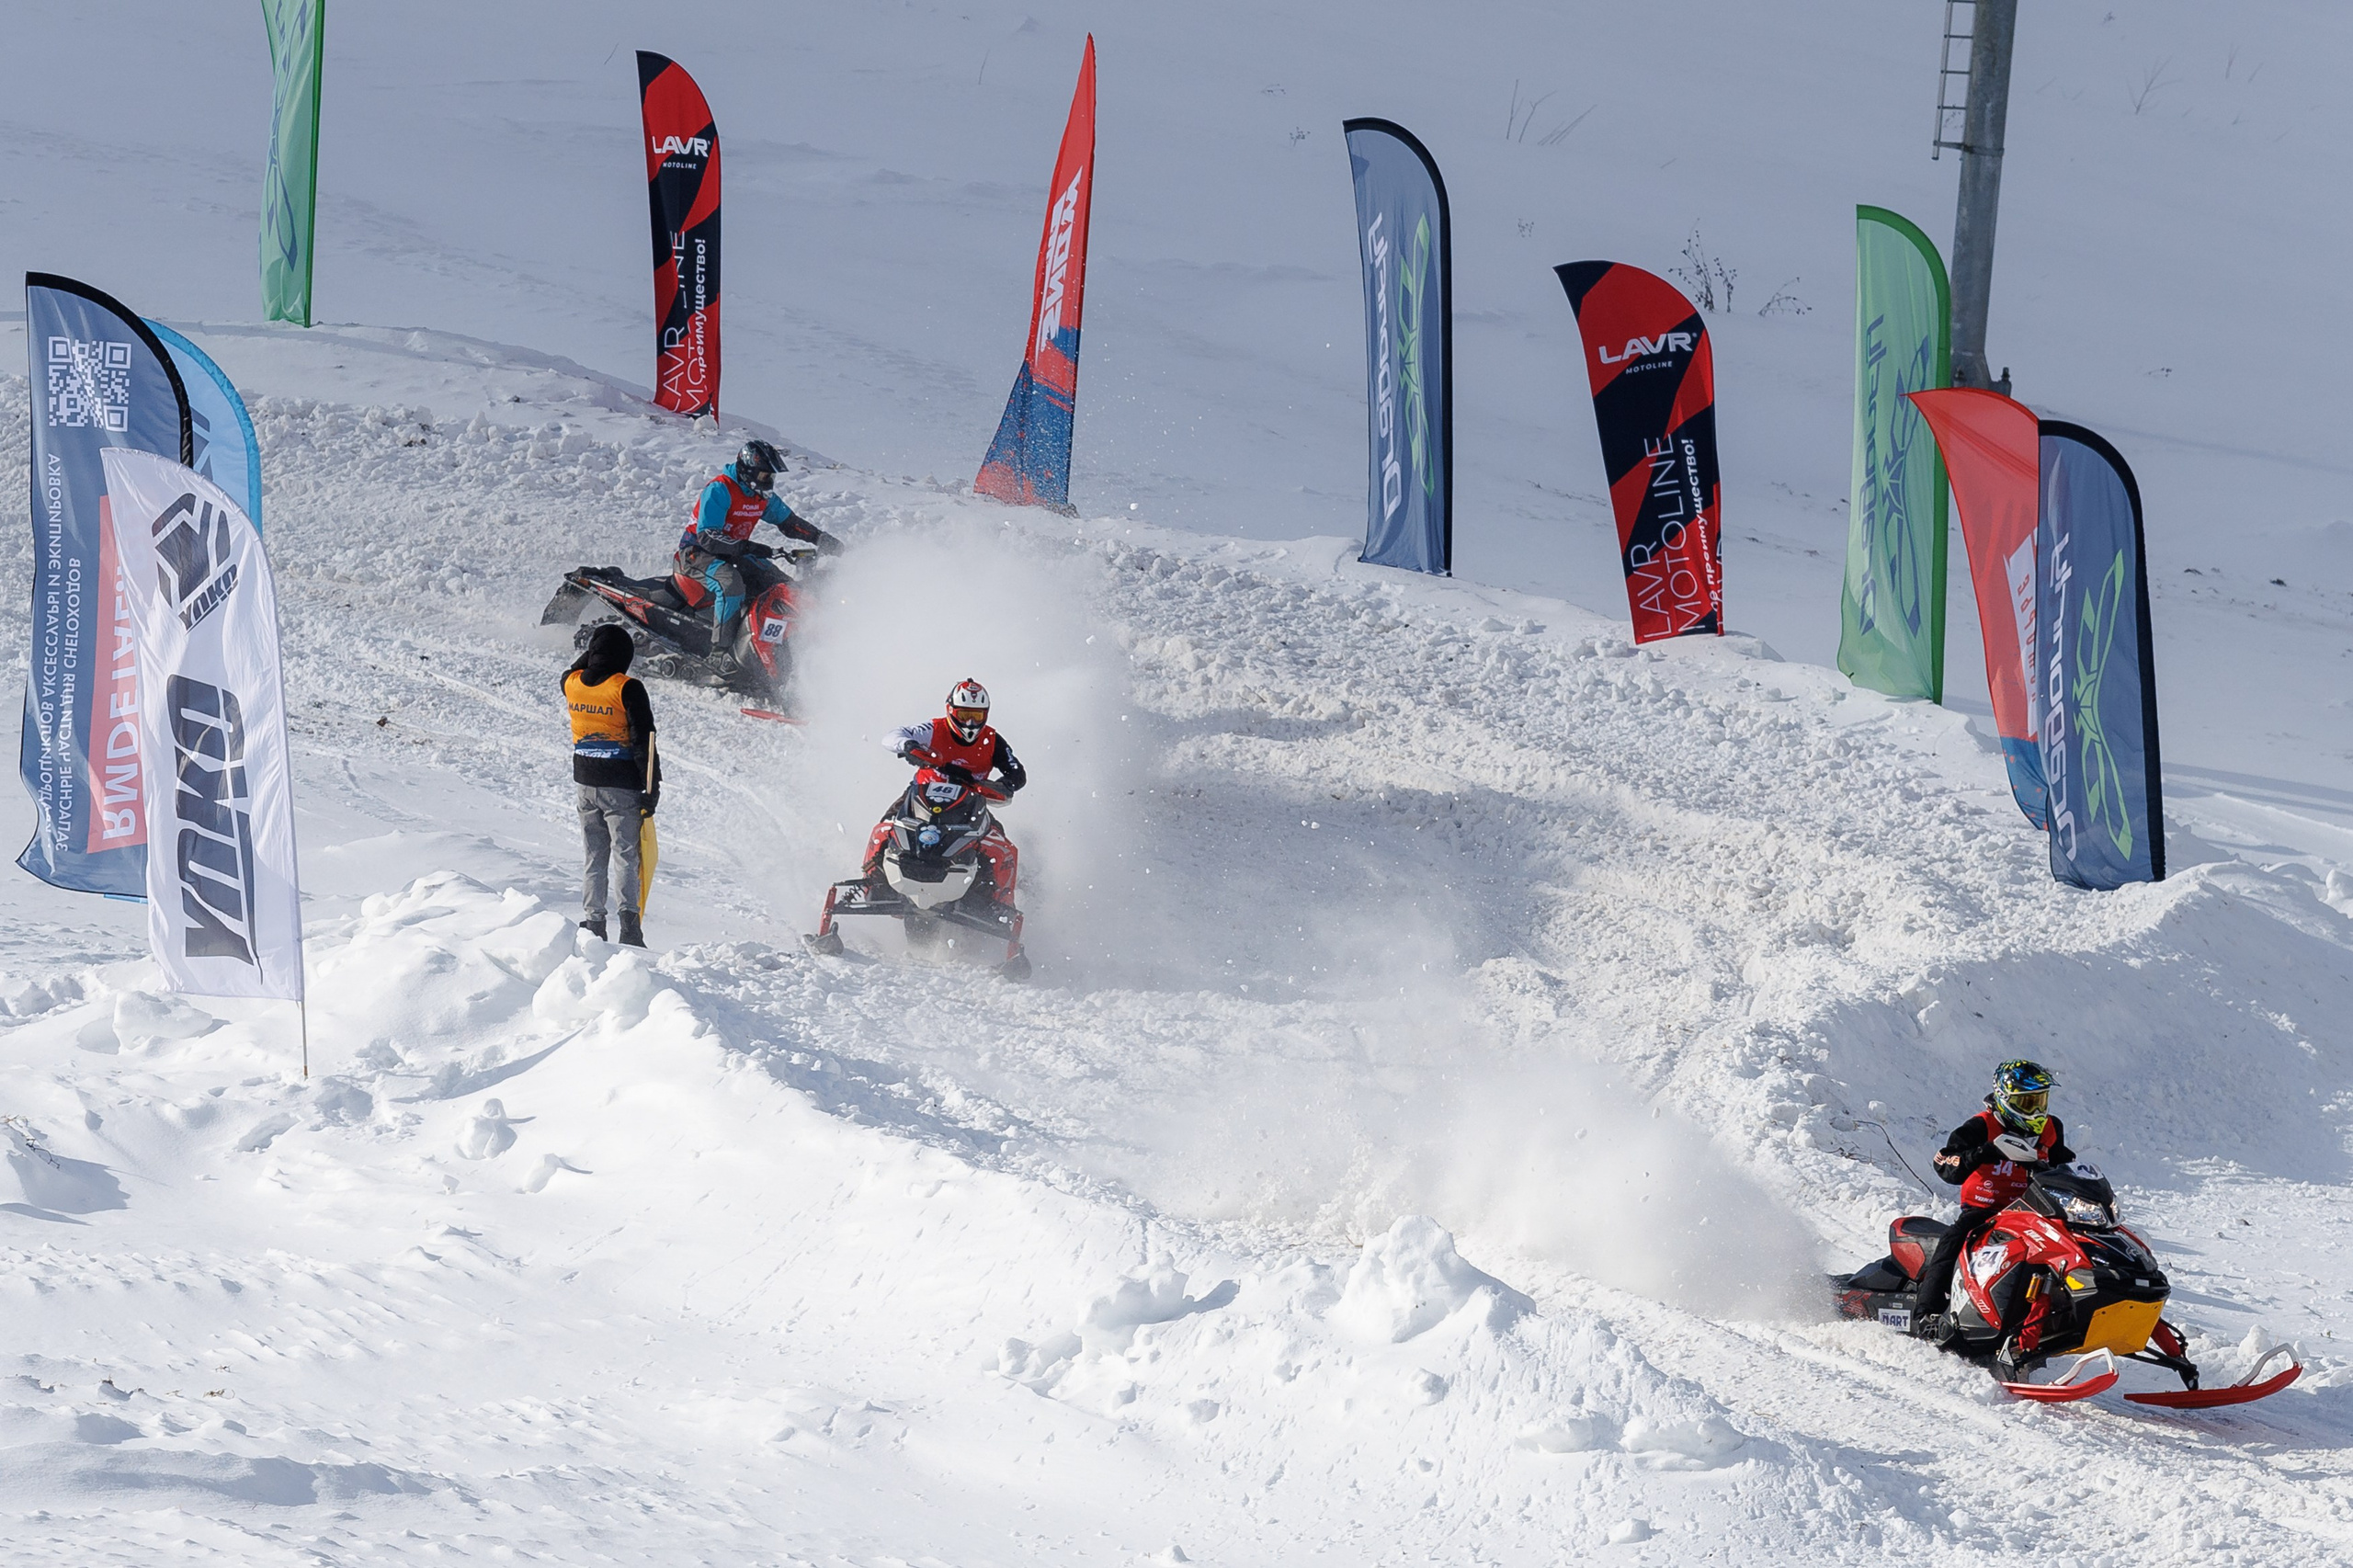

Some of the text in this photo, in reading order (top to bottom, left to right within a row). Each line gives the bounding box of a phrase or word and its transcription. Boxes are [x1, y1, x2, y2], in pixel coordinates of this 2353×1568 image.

[652, 136, 709, 158] LAVR
[663, 162, 697, 170] MOTOLINE
[1598, 332, 1694, 366] LAVR
[1625, 360, 1673, 374] MOTOLINE
[1681, 438, 1715, 585] преимущество!
[1643, 434, 1705, 633] MOTOLINE
[1631, 541, 1672, 639] LAVR
[764, 623, 783, 638] 88
[932, 785, 954, 794] 46
[1992, 1160, 2013, 1176] 34
[1977, 1251, 2000, 1267] 34
